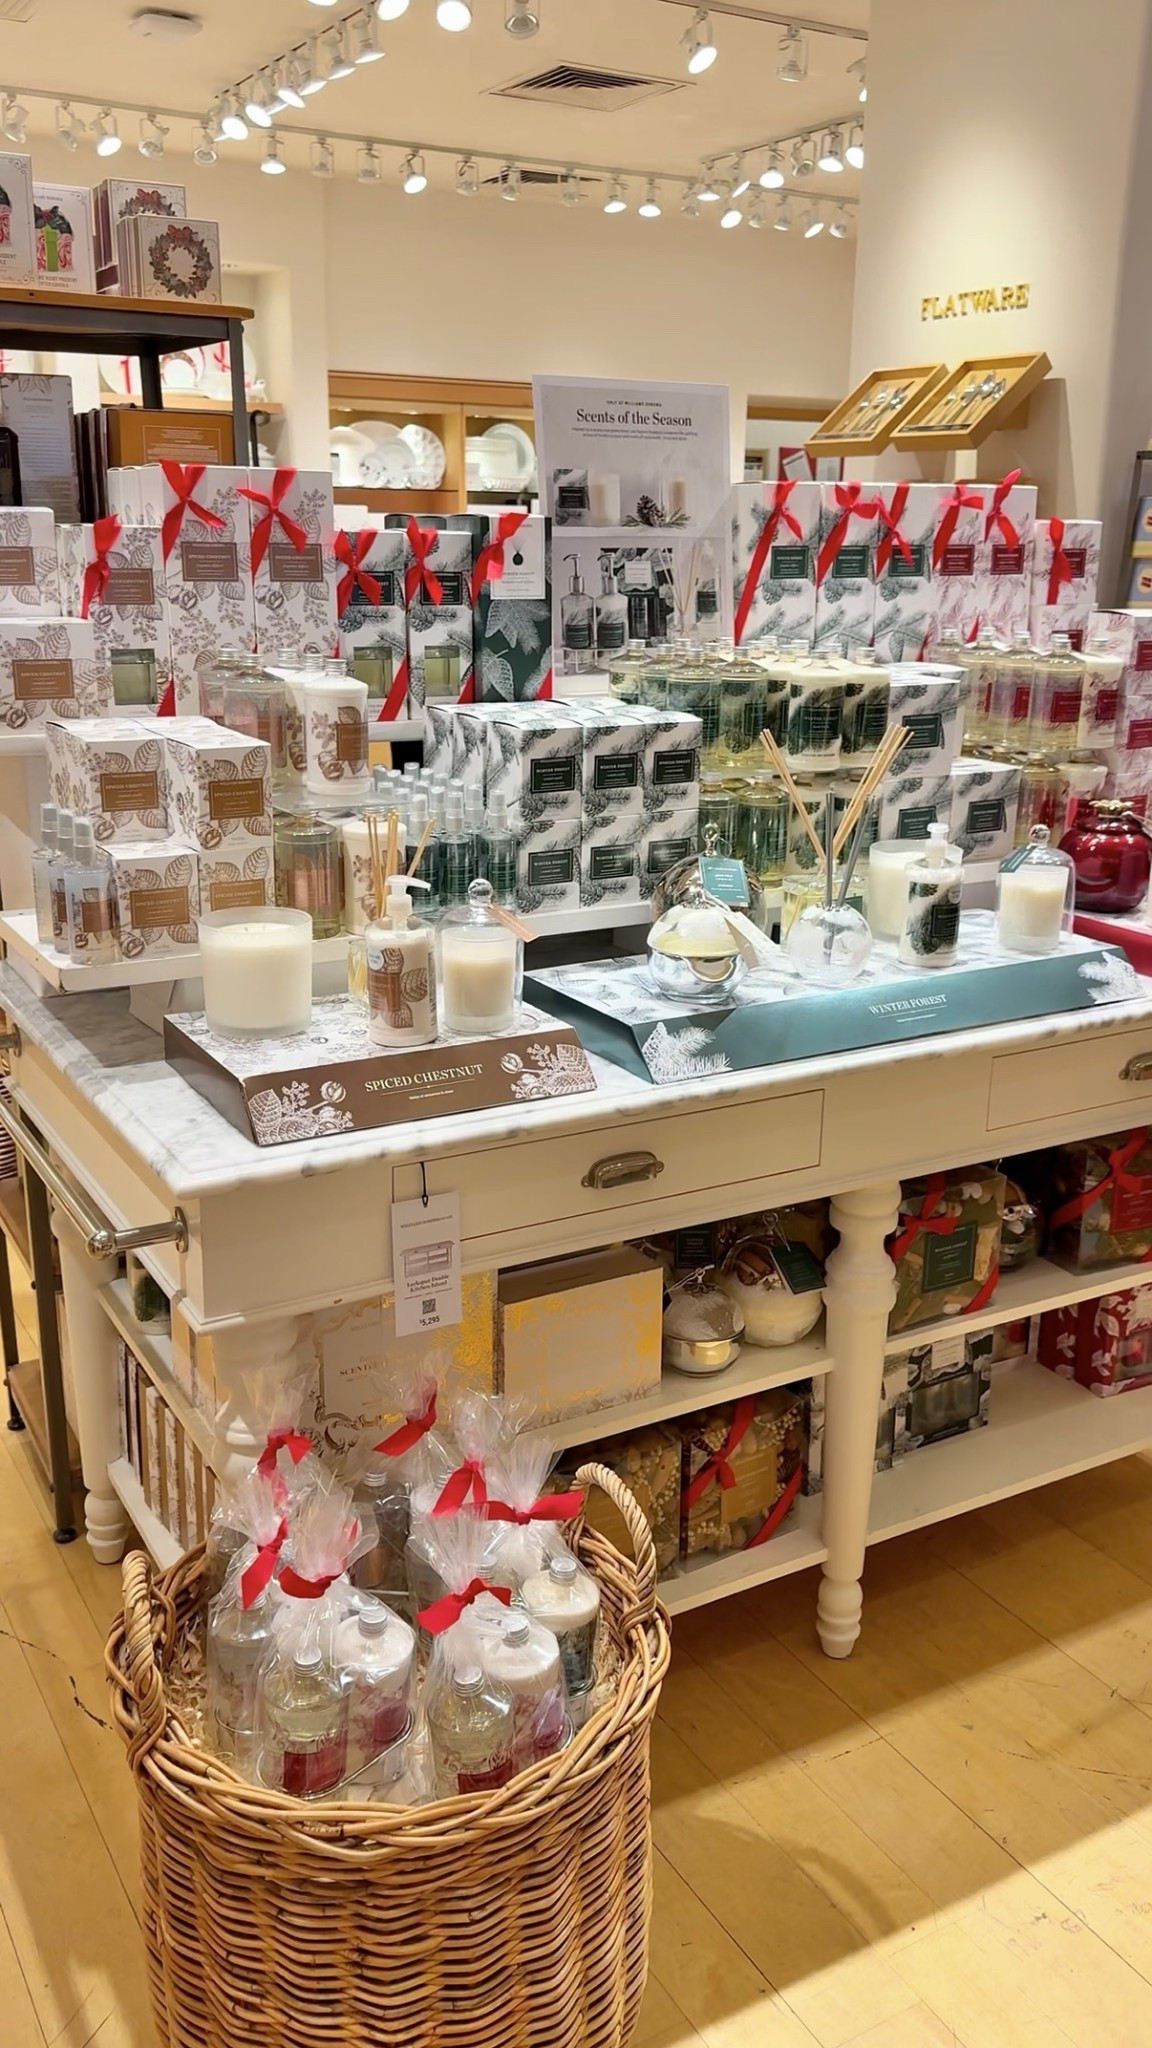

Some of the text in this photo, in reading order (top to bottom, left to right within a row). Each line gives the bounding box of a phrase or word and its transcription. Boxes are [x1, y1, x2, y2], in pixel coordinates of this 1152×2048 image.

[921, 284, 1029, 321] FLATWARE
[576, 409, 692, 427] Scents of the Season
[868, 994, 947, 1015] WINTER FOREST
[364, 1064, 483, 1092] SPICED CHESTNUT
